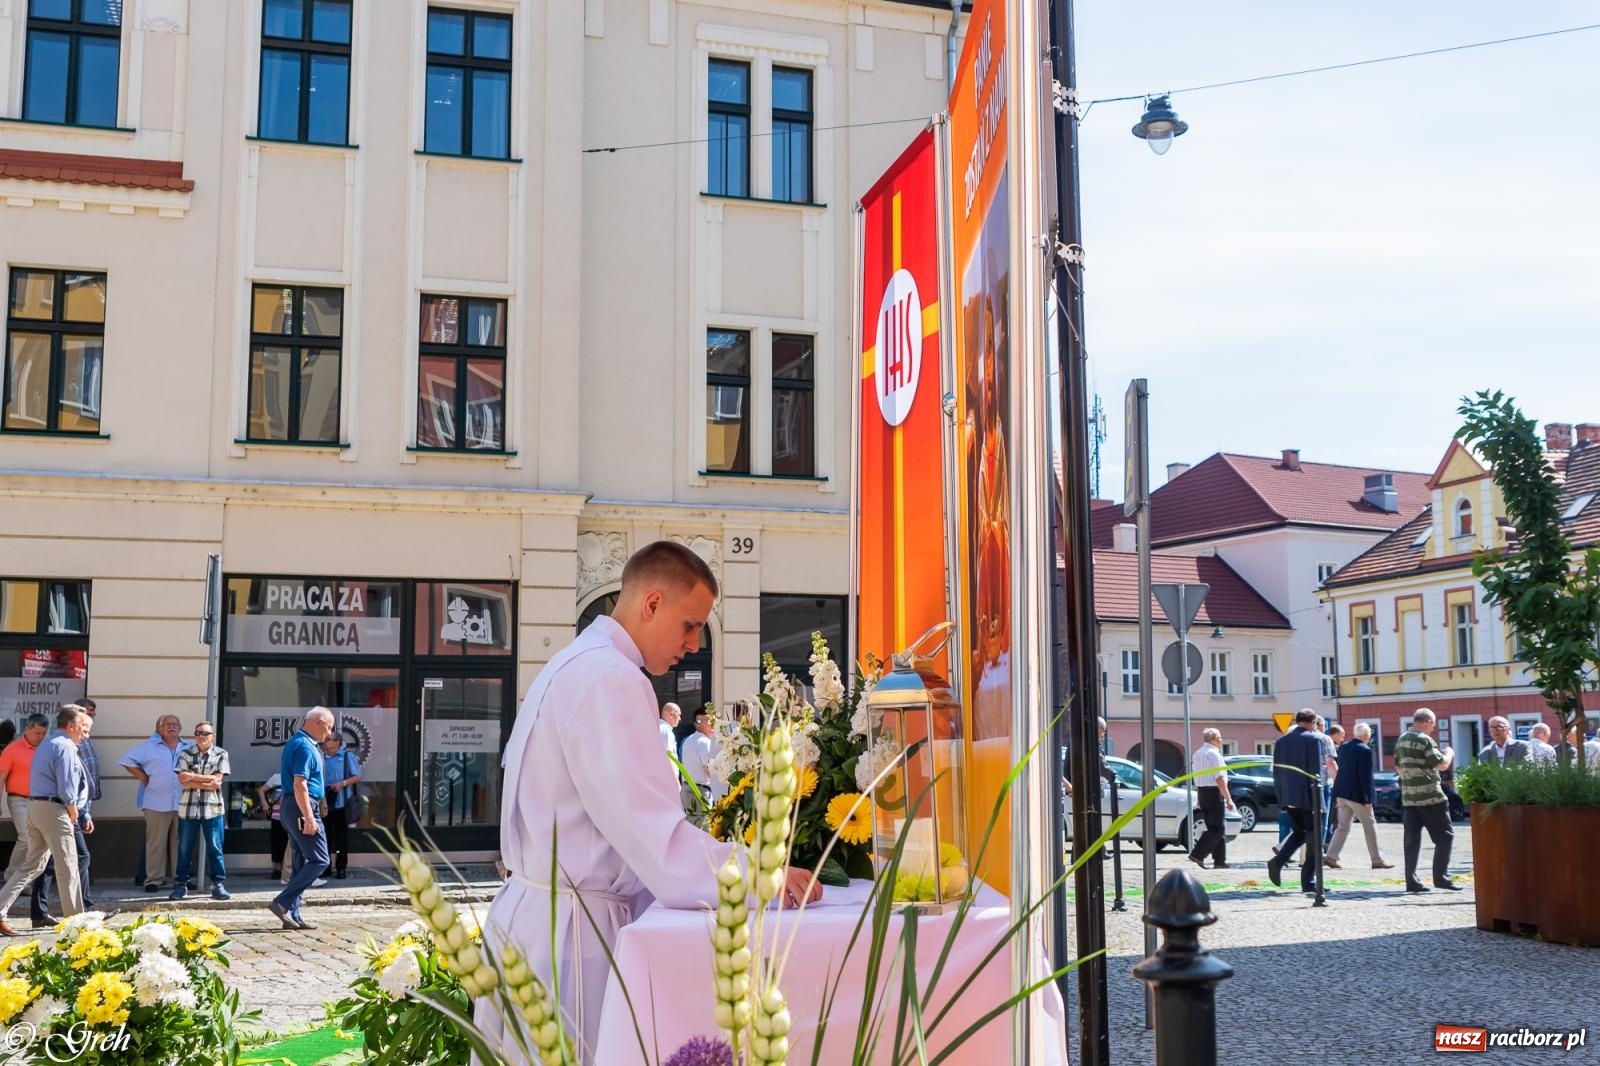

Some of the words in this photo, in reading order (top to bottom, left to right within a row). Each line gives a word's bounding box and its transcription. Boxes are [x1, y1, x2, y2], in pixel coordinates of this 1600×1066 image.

[974, 9, 992, 110] PANIE
[884, 290, 913, 397] IHS
[732, 537, 754, 554] 39
[266, 584, 334, 611] PRACA
[337, 587, 364, 612] ZA
[268, 620, 360, 652] GRANICĄ
[17, 681, 61, 695] NIEMCY
[253, 716, 307, 740] BEK
